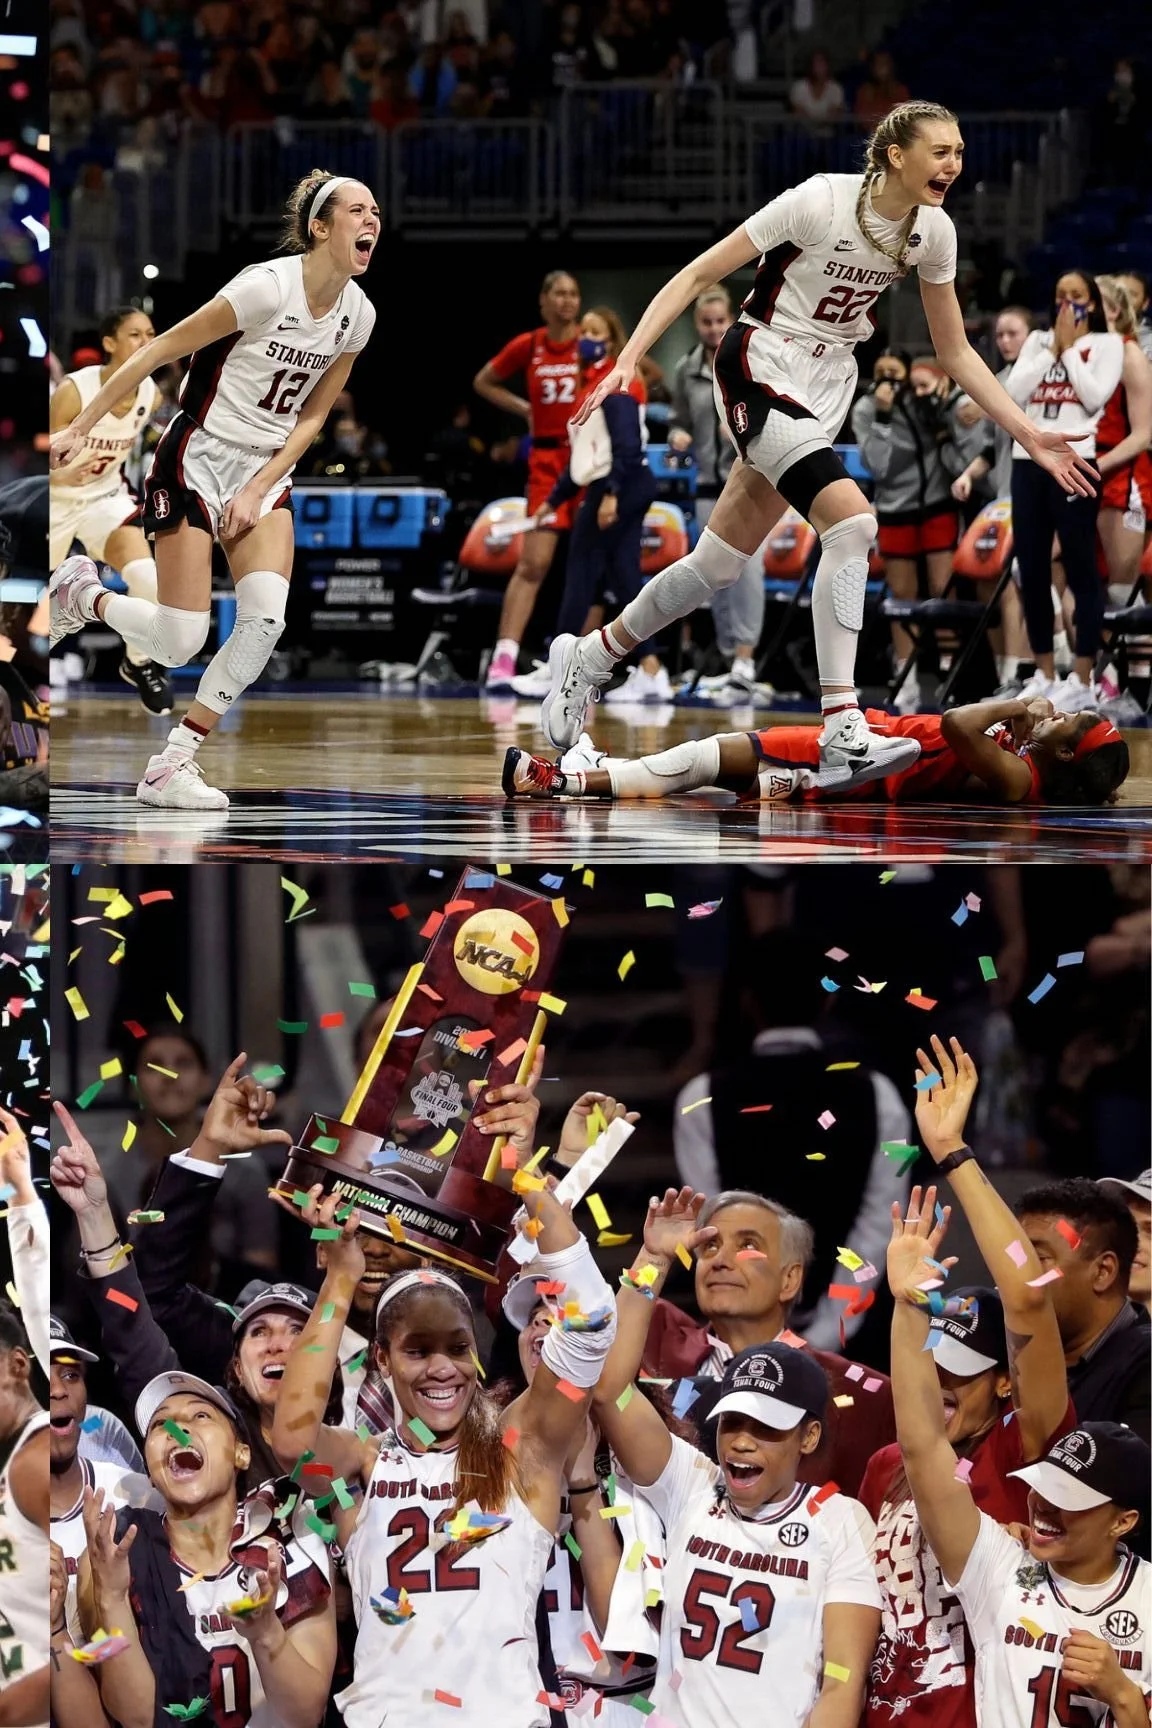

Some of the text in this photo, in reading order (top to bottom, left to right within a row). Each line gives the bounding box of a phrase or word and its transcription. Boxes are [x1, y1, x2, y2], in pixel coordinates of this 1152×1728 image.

[823, 260, 897, 286] STANFOR
[811, 284, 880, 324] 22
[265, 340, 335, 370] STANFOR
[256, 368, 310, 414] 12
[540, 376, 576, 404] 32
[414, 1090, 459, 1113] FINAL FOUR
[397, 1146, 445, 1172] BASKETBALL
[391, 1203, 459, 1241] CHAMPION
[946, 1322, 967, 1339] FOUR
[733, 1378, 776, 1392] FINAL FOUR
[1061, 1455, 1082, 1473] FOUR
[780, 1522, 806, 1546] SEC
[386, 1505, 481, 1595] 22
[686, 1534, 809, 1581] OUTH CAROLINA
[679, 1567, 776, 1675] 52
[1108, 1612, 1137, 1638] SEC
[1004, 1624, 1059, 1654] SOUTH
[1027, 1664, 1099, 1728] 15
